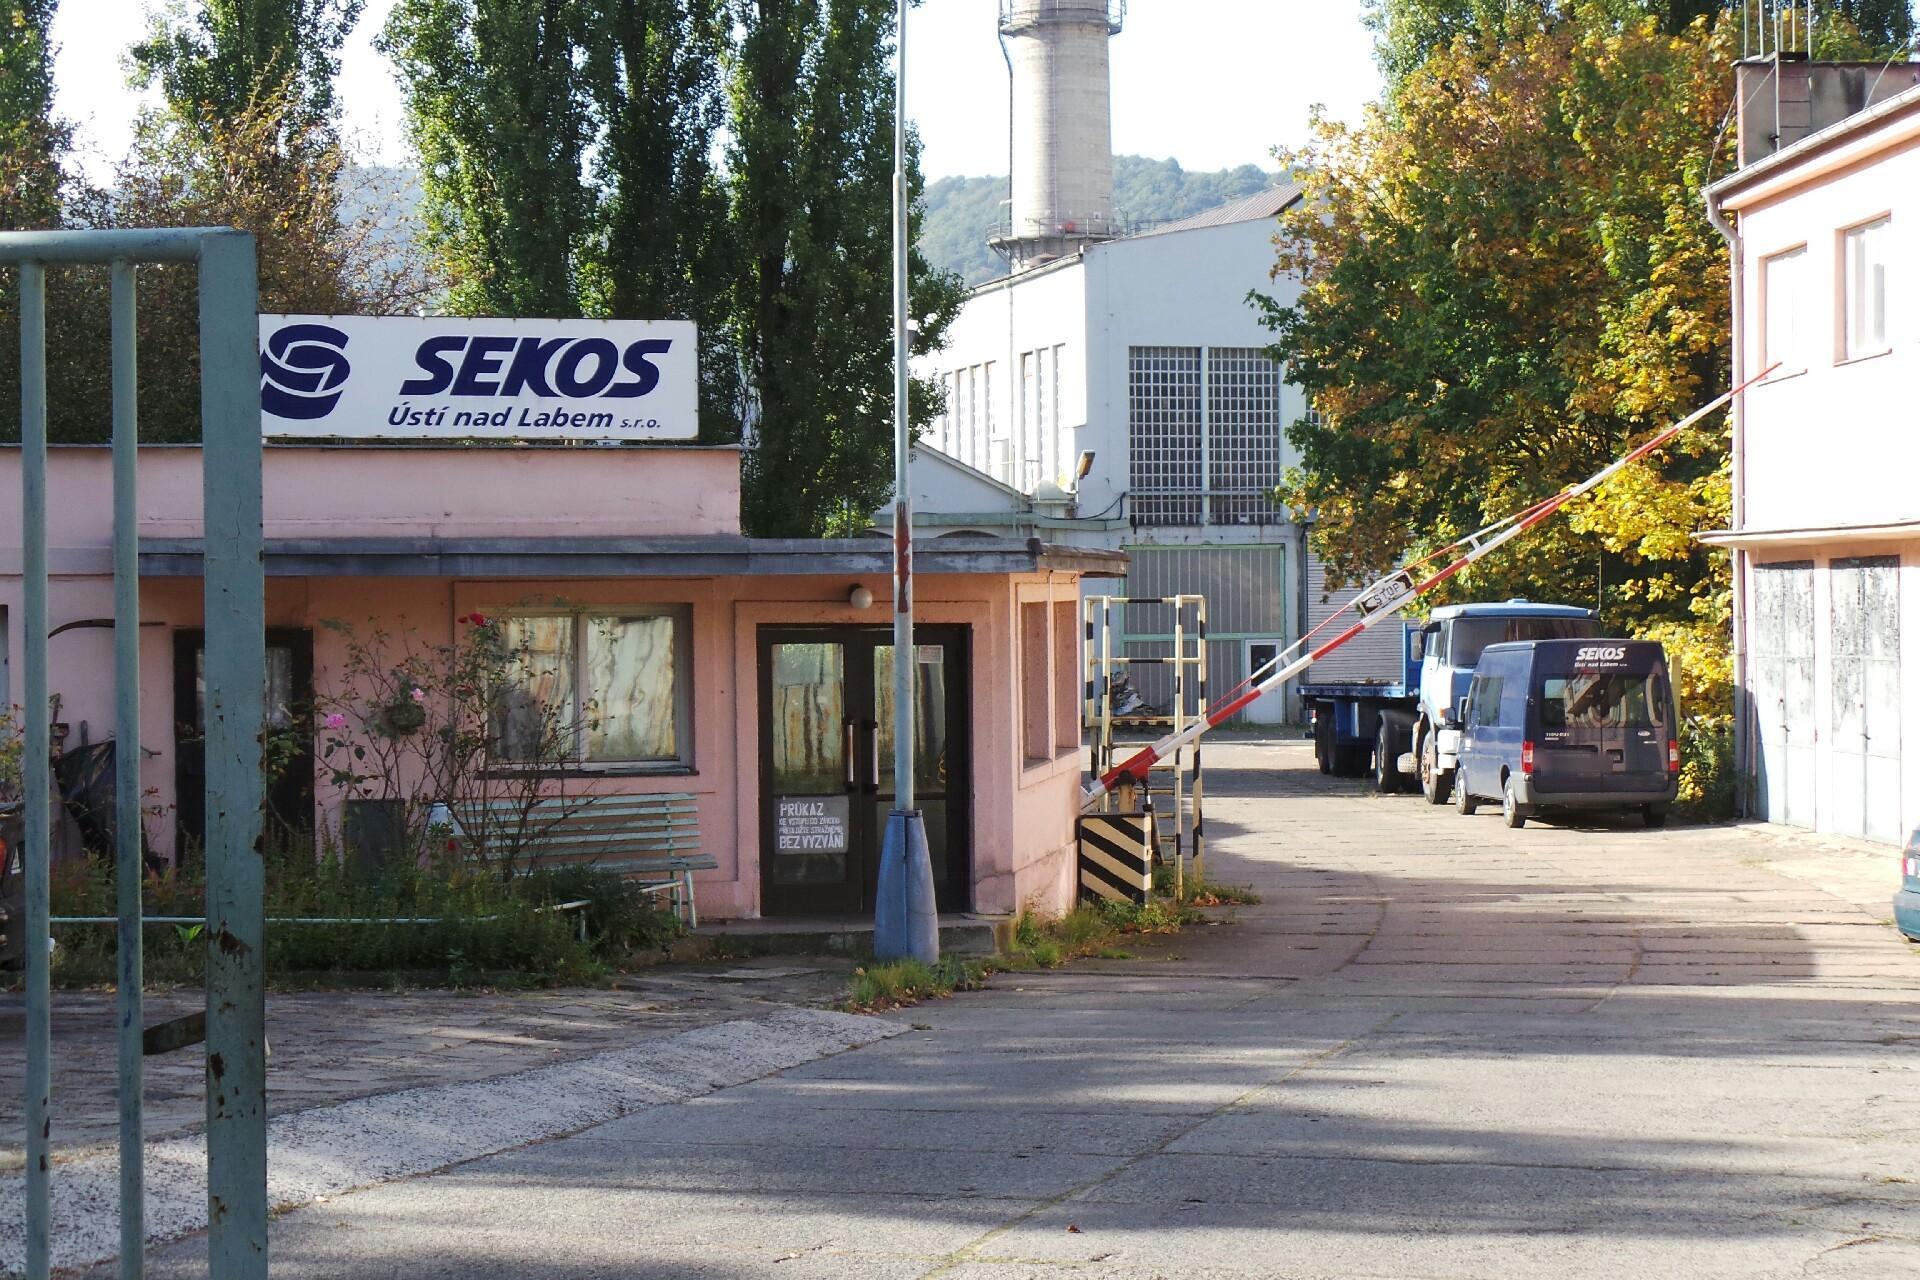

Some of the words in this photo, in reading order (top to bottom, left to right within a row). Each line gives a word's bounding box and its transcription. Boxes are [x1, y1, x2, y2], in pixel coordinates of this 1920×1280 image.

[398, 335, 673, 398] SEKOS
[388, 401, 450, 427] Ústí
[453, 406, 513, 427] nad
[517, 407, 614, 428] Labem
[620, 417, 661, 428] s.r.o.
[1373, 582, 1400, 606] STOP
[1575, 647, 1626, 660] SEKOS
[780, 801, 824, 816] PRŮKAZ
[779, 834, 800, 849] BEZ
[801, 832, 844, 849] VYZVÁNÍ
